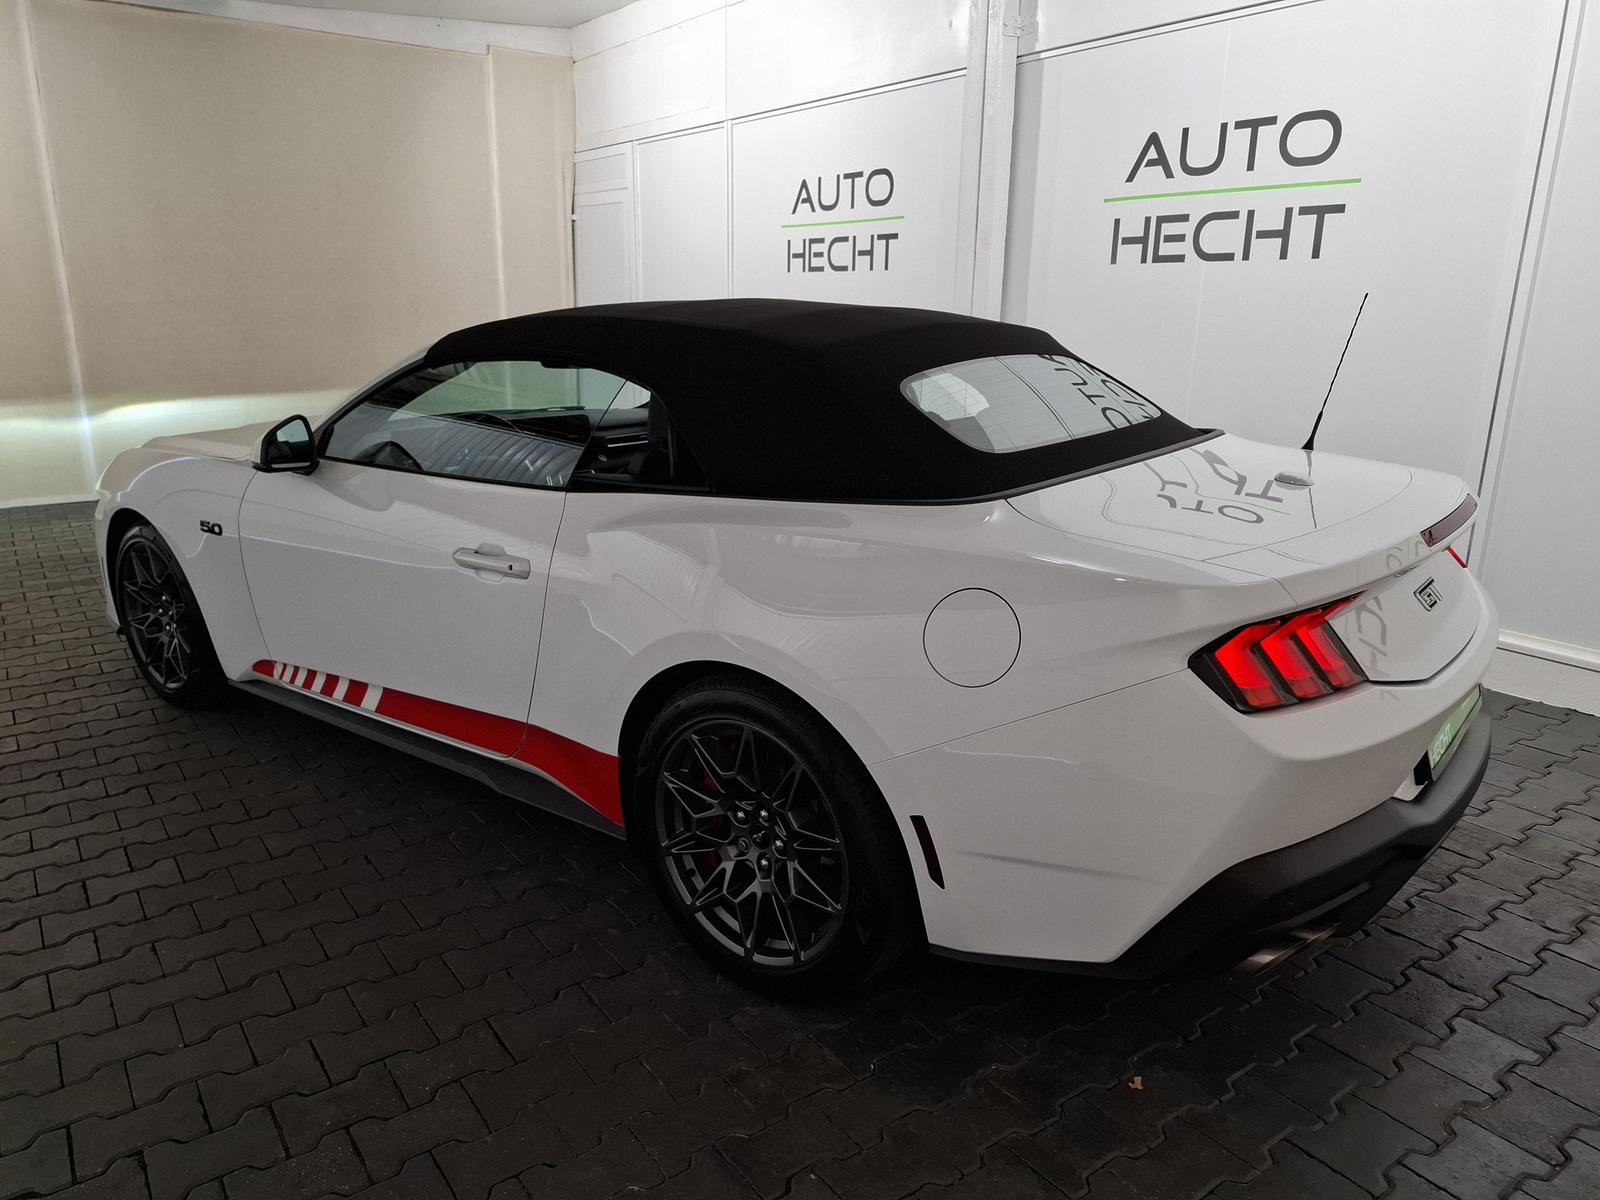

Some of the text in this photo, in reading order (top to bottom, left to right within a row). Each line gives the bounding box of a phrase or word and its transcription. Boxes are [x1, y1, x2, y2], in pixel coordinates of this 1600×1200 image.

[1125, 109, 1343, 184] AUTO
[791, 168, 895, 215] AUTO
[787, 232, 899, 273] HECHT
[1110, 203, 1347, 265] HECHT
[1413, 576, 1443, 612] GT
